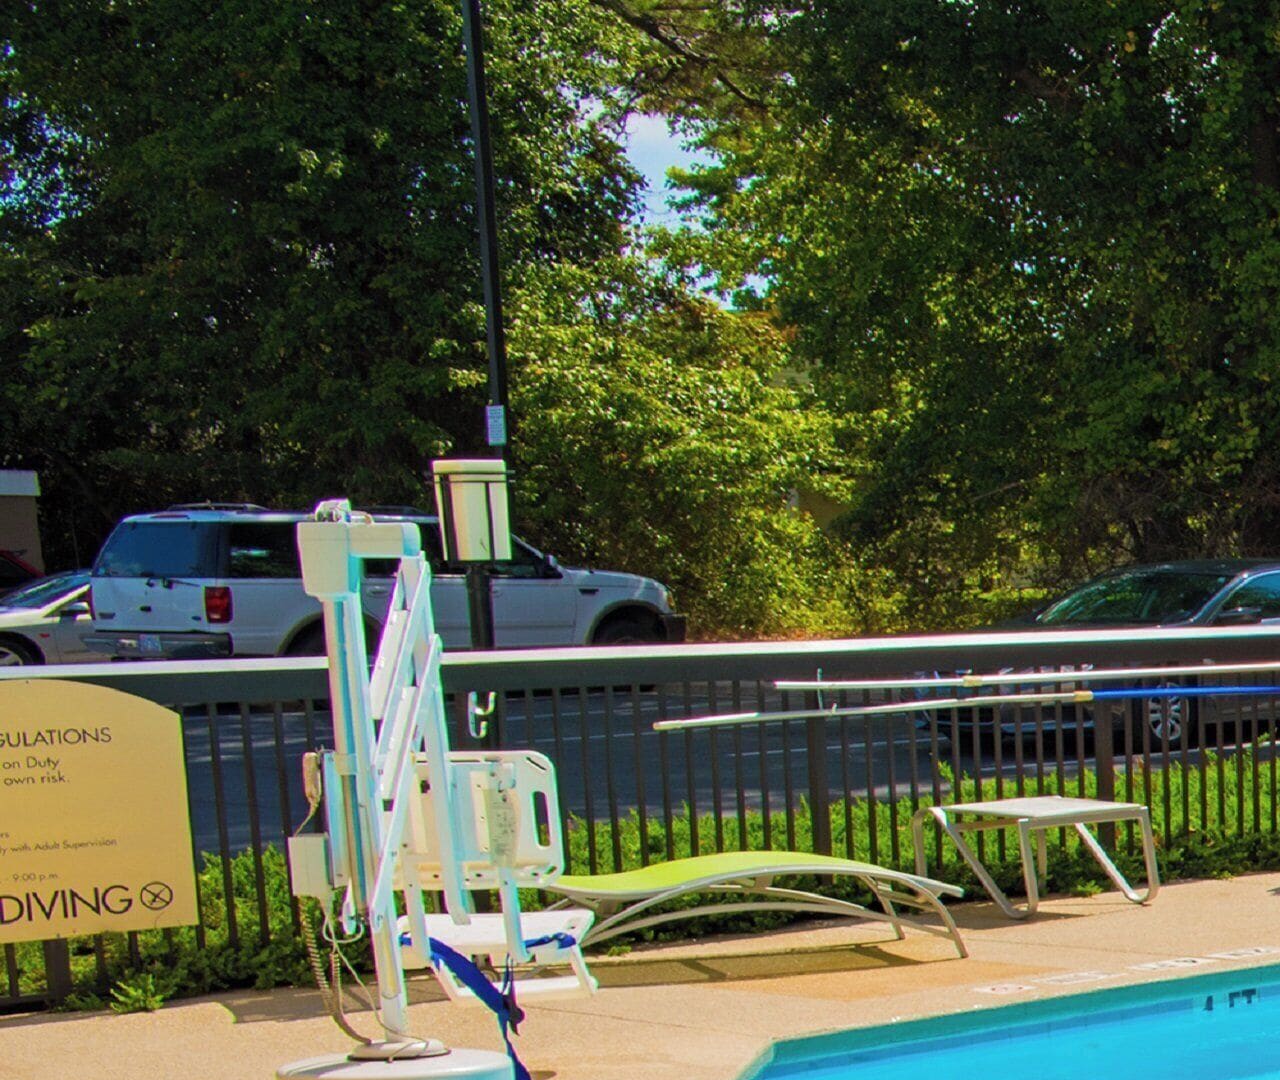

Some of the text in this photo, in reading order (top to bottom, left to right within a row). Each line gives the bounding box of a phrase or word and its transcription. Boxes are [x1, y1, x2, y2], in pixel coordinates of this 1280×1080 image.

[2, 755, 60, 771] on Duty
[3, 770, 70, 786] own risk.
[35, 840, 60, 851] Adult
[62, 837, 118, 851] Supervision
[0, 884, 133, 925] DIVING
